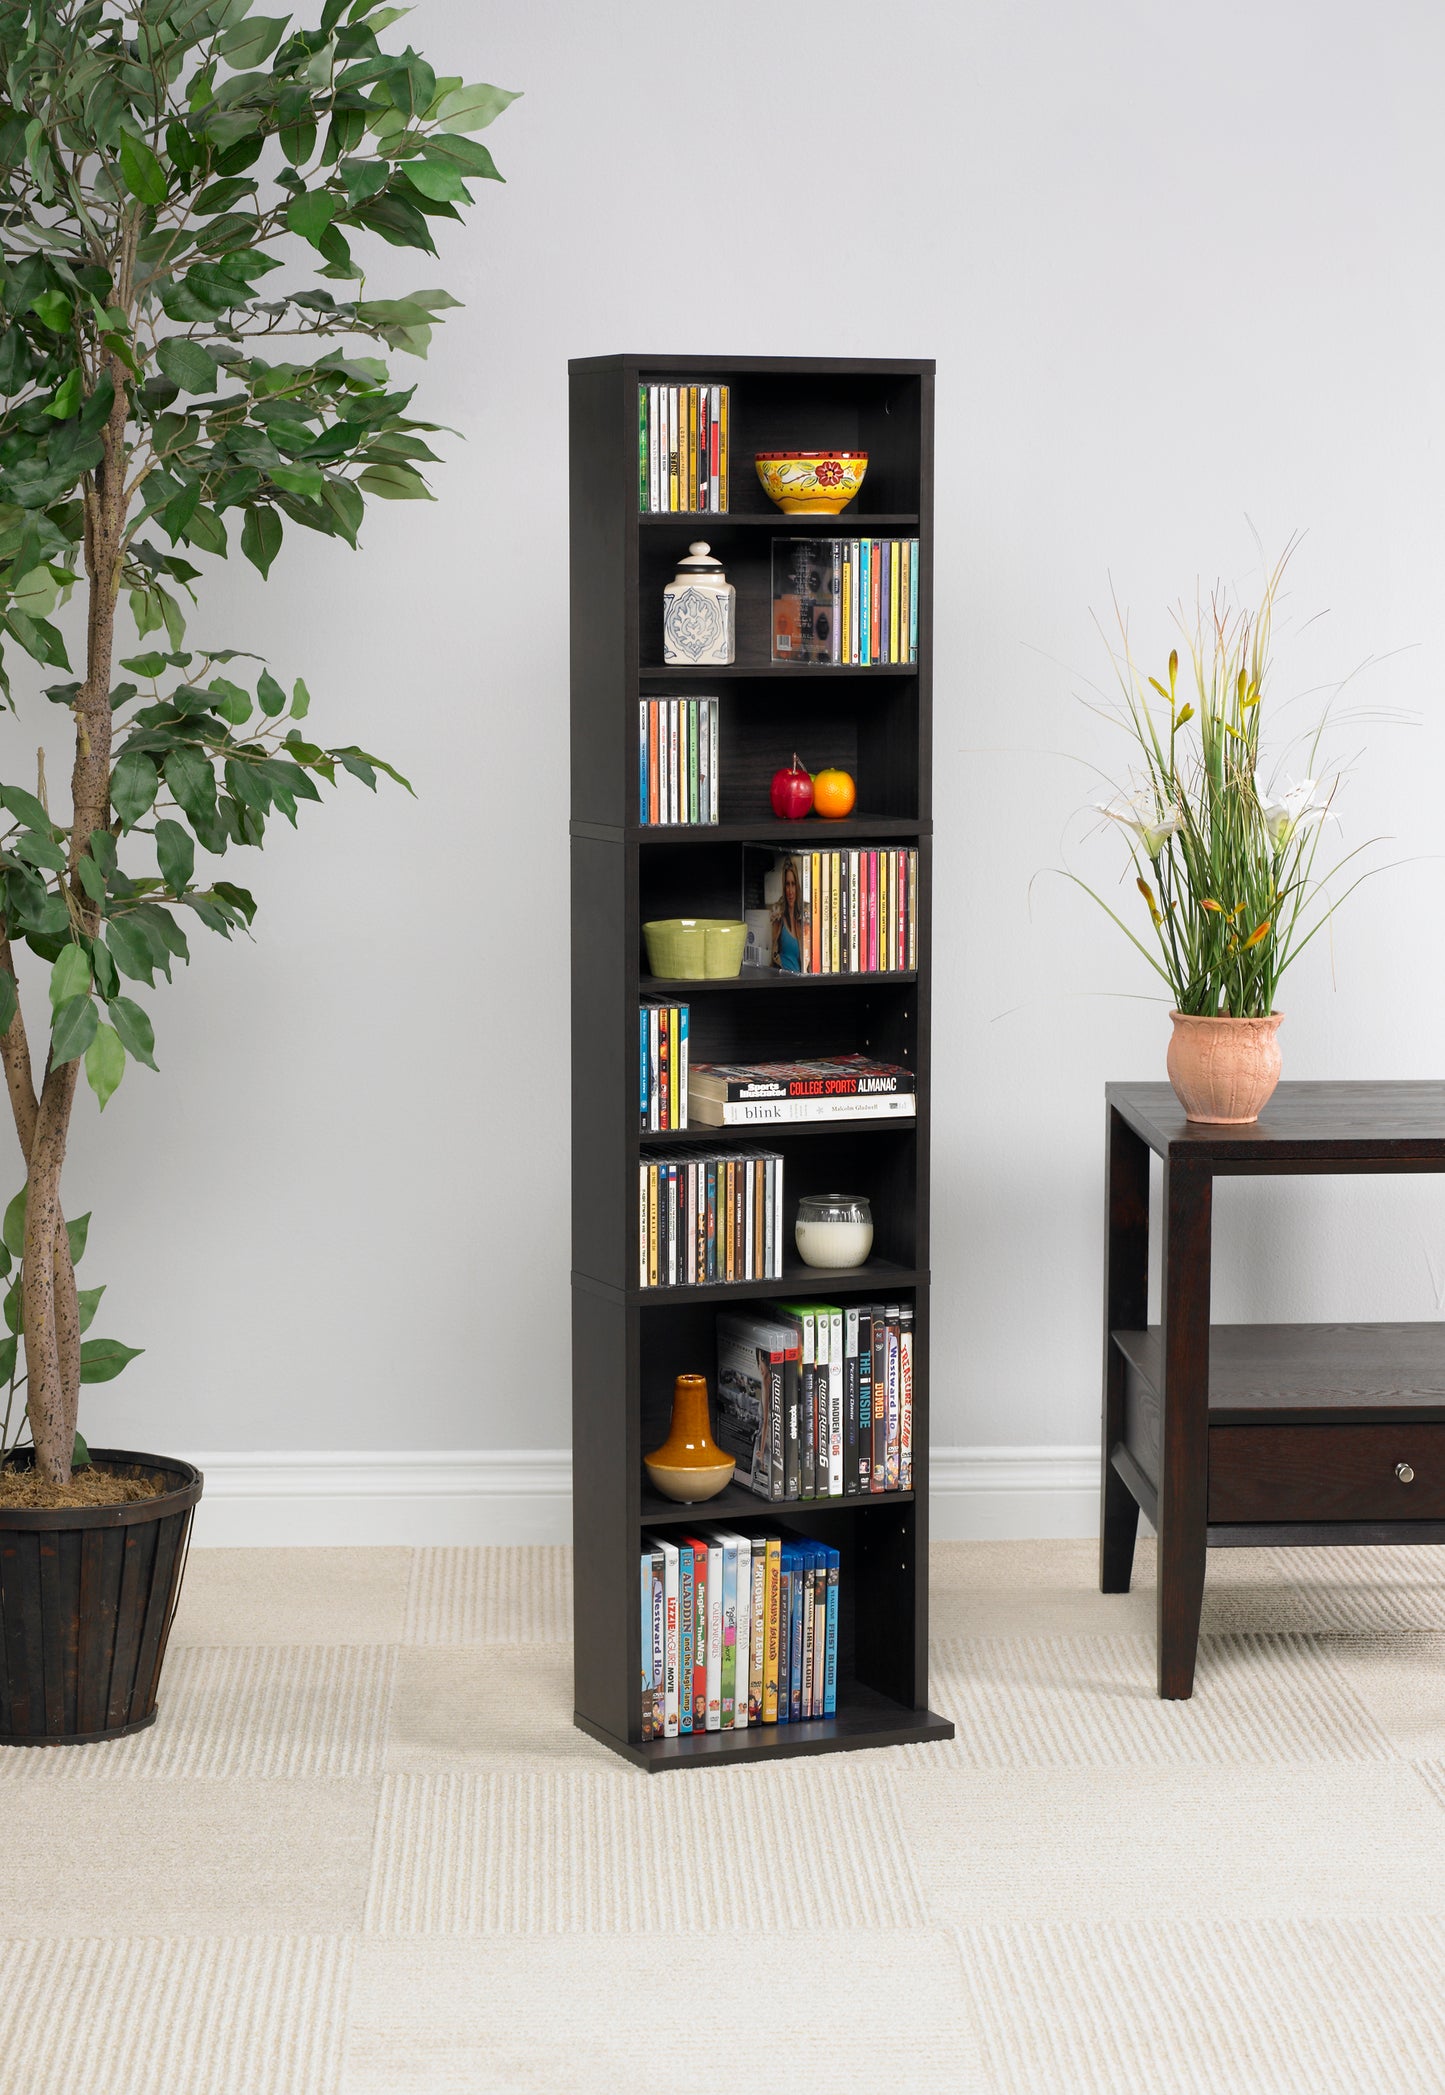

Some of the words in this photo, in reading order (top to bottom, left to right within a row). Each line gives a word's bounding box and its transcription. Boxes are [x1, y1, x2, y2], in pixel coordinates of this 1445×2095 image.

[748, 1083, 779, 1091] Sports
[790, 1081, 823, 1096] COLLEGE
[826, 1080, 856, 1093] SPORTS
[858, 1077, 896, 1092] ALMANAC
[745, 1106, 781, 1119] blink
[855, 1103, 878, 1111] Gladwell
[860, 1350, 870, 1374] THE
[900, 1344, 912, 1406] TREASURE
[772, 1374, 781, 1410] RIDGE
[875, 1383, 884, 1418] DUMBO
[860, 1386, 870, 1428] INSIDE
[890, 1414, 897, 1429] Ho
[902, 1409, 911, 1448] ISLAND
[772, 1413, 781, 1456] RACER
[832, 1445, 840, 1456] 06
[819, 1455, 828, 1468] 6
[755, 1564, 764, 1616] PRISONER
[683, 1572, 692, 1633] ALADDIN
[755, 1619, 763, 1632] OF
[655, 1660, 662, 1675] Ho
[782, 1667, 786, 1676] 3
[683, 1668, 691, 1690] Magic
[683, 1692, 691, 1711] lamp
